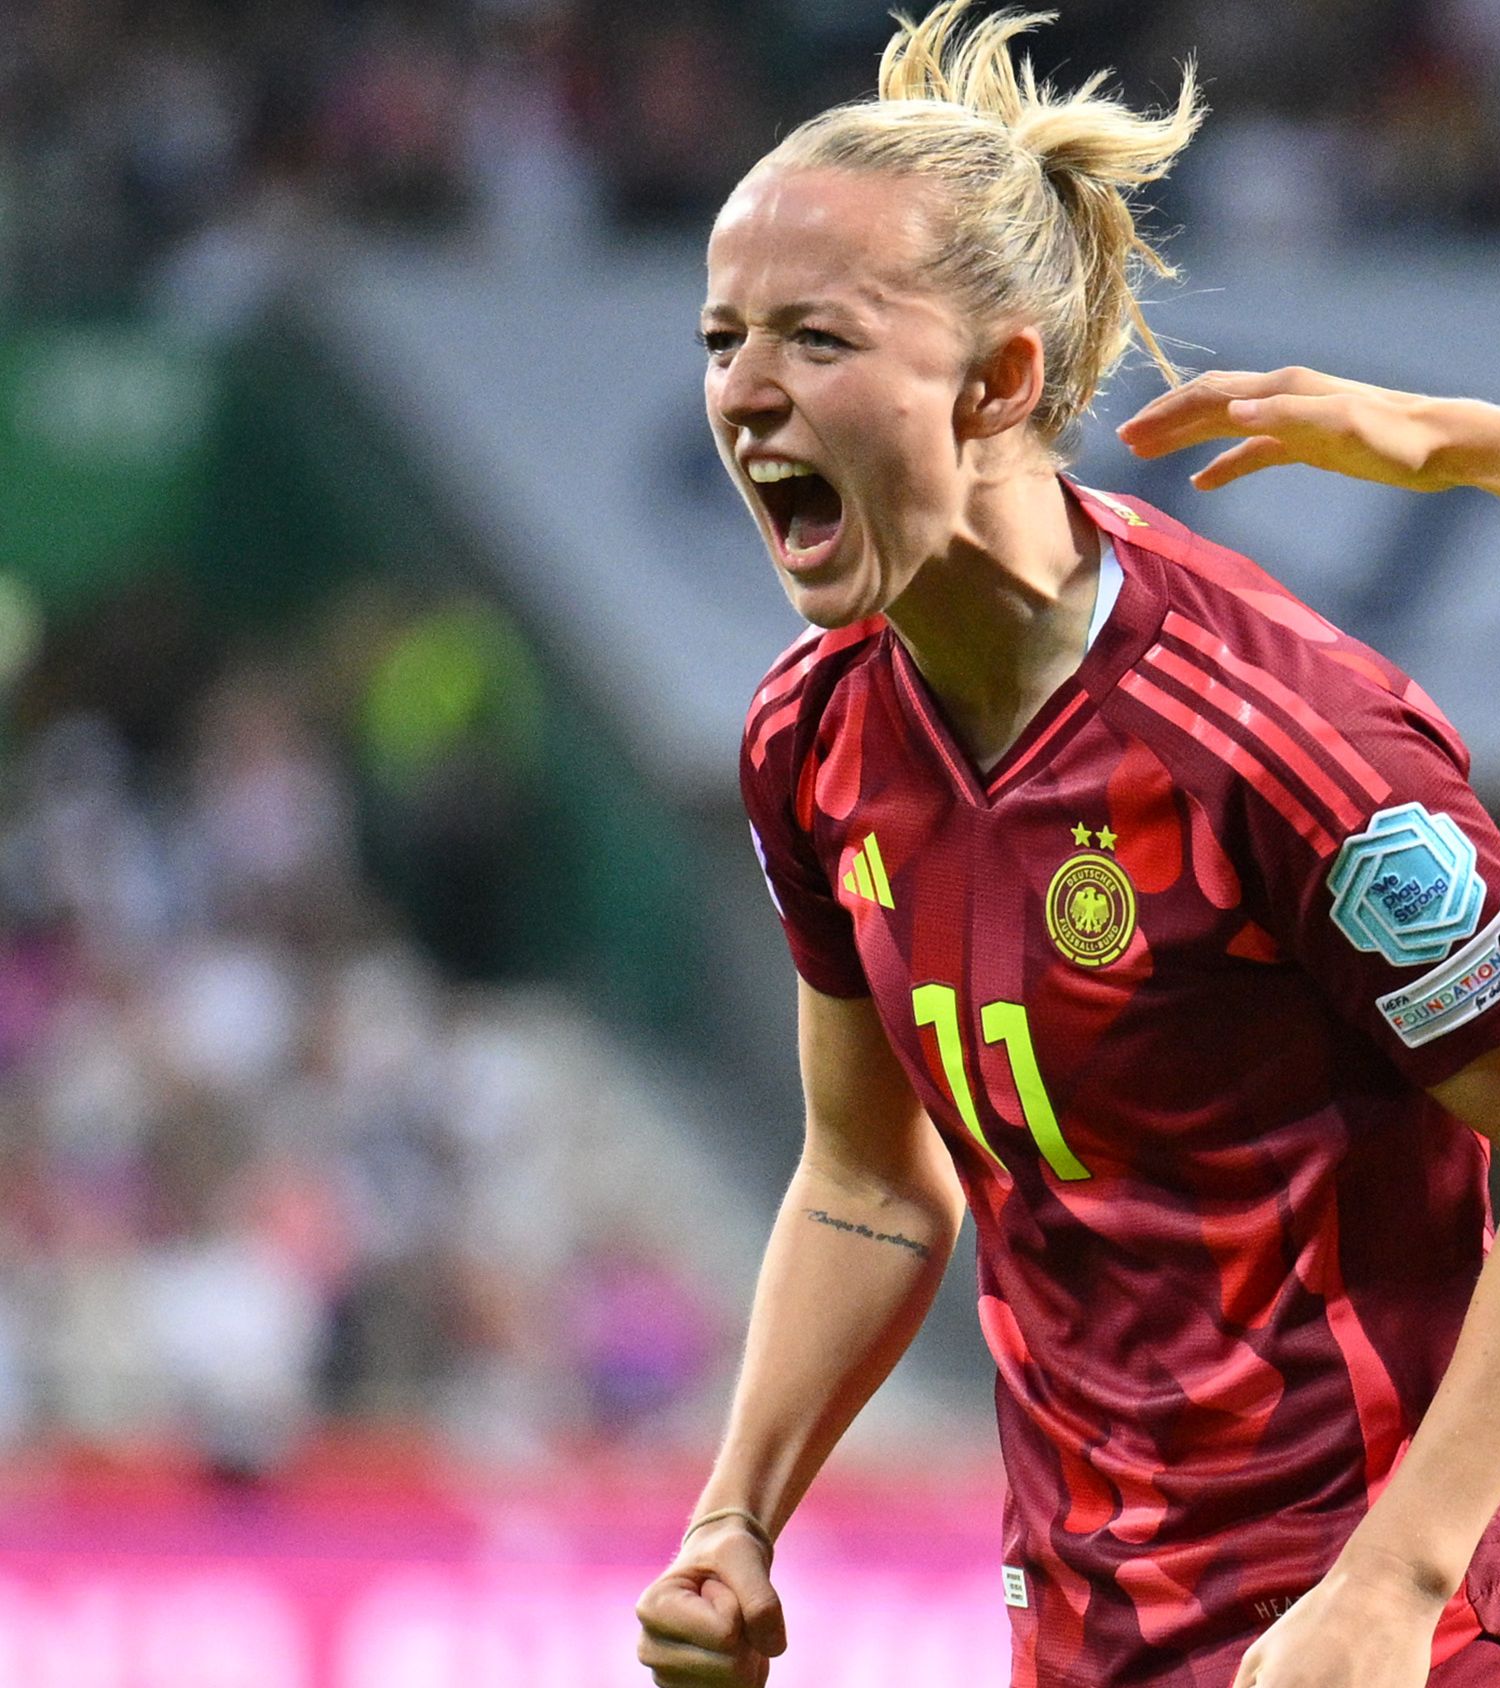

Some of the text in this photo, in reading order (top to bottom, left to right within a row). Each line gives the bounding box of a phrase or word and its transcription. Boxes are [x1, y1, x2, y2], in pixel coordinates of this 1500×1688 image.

[1066, 869, 1117, 893] DEUTSCHER
[1370, 874, 1399, 893] We
[1382, 995, 1410, 1012] UEFA
[912, 983, 1092, 1181] 11
[1254, 1596, 1302, 1620] HEA
